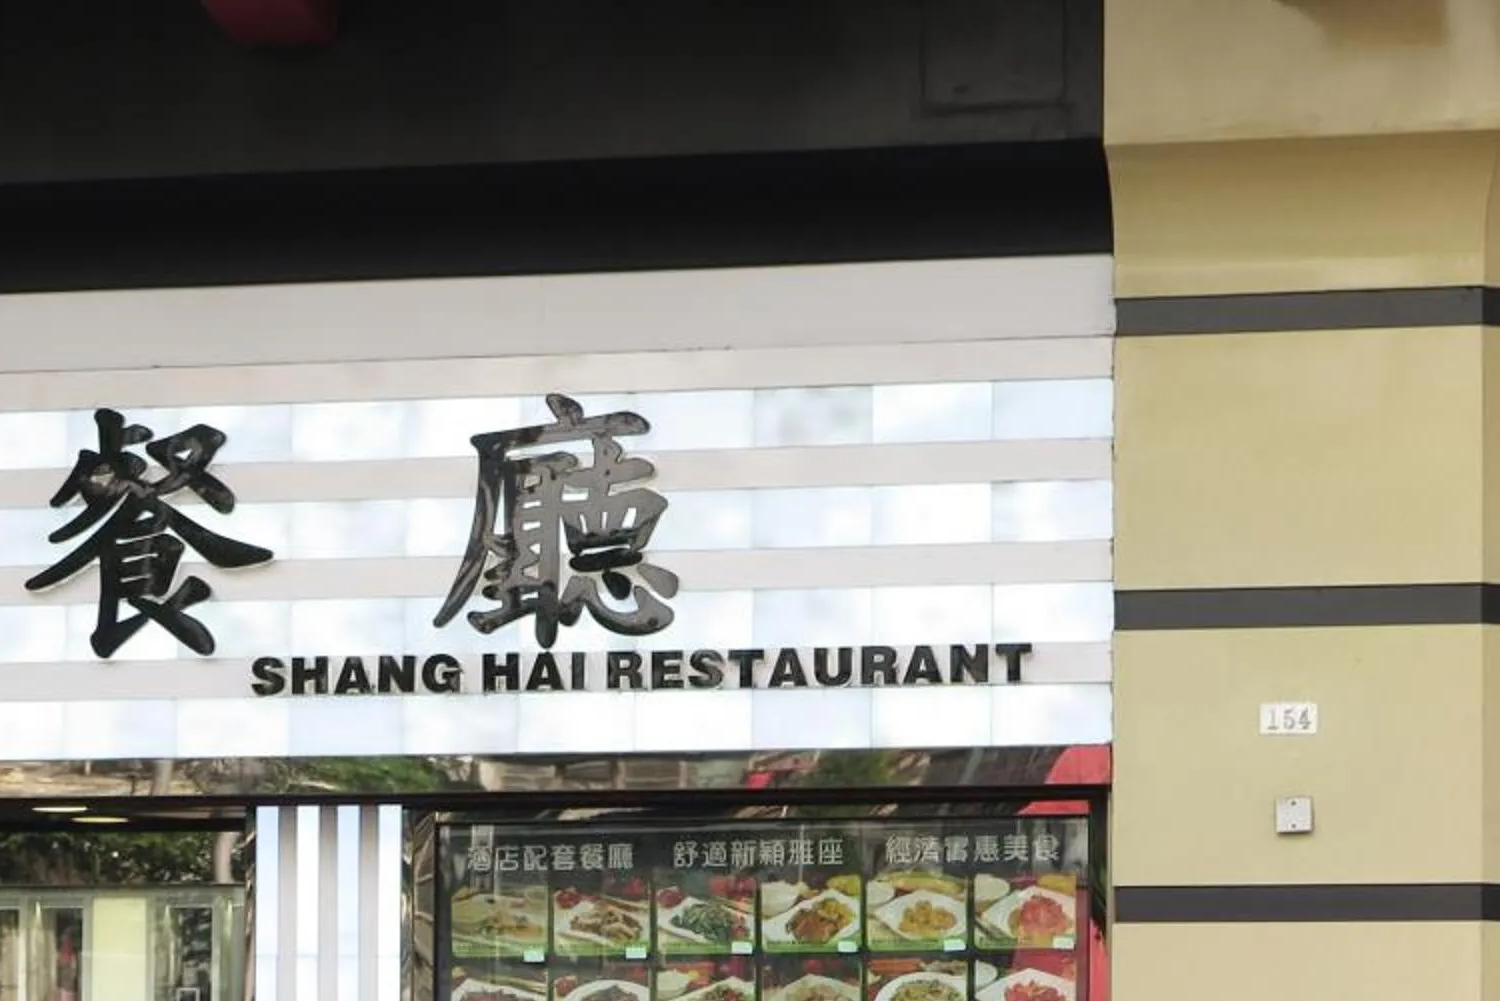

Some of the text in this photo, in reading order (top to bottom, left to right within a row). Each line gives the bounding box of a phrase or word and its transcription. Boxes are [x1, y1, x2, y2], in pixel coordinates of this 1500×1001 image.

[251, 642, 1033, 697] SHANG HAI RESTAURANT
[1267, 706, 1312, 731] 154
